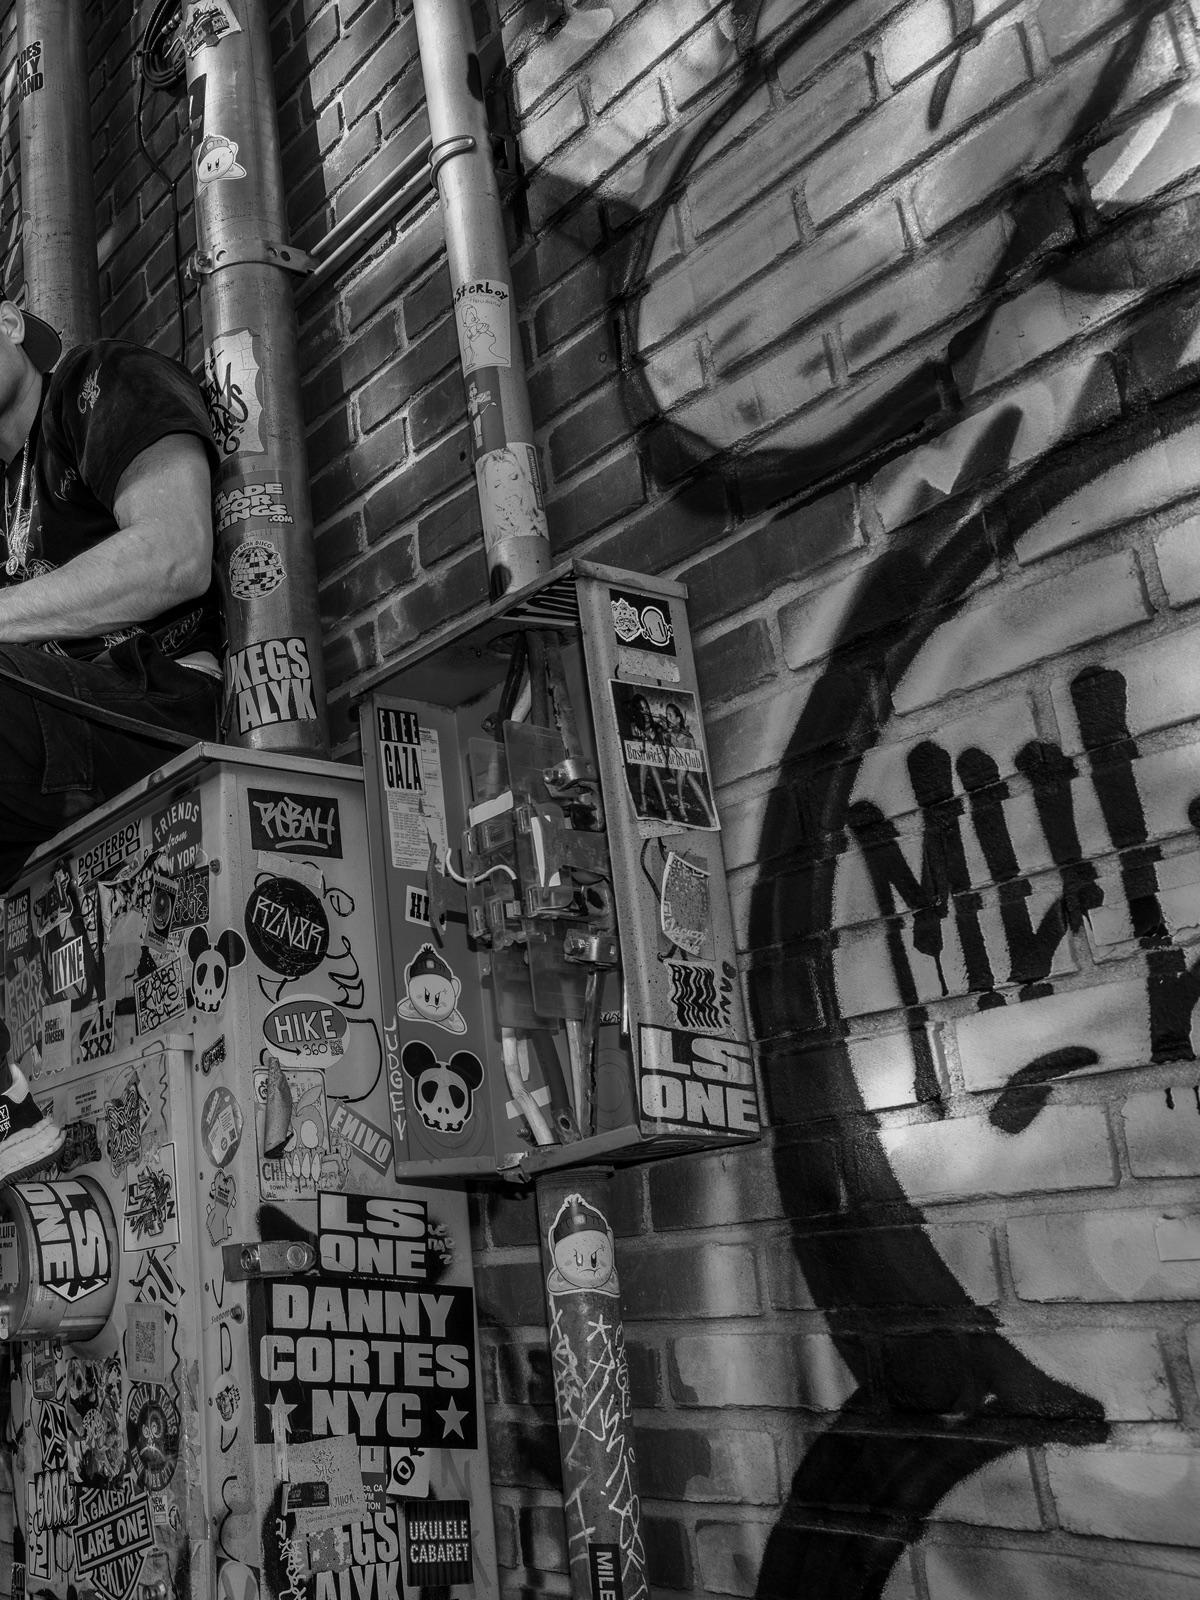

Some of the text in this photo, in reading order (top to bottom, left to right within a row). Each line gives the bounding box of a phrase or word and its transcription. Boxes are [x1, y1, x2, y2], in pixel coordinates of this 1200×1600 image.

[219, 494, 274, 520] FOR
[268, 514, 294, 524] .COM
[230, 639, 310, 694] KEGS
[238, 678, 317, 735] ALYK
[379, 709, 420, 744] FREE
[384, 743, 422, 791] GAZA
[154, 801, 201, 843] FRIENDS
[167, 831, 188, 847] from
[78, 818, 142, 875] POSTERBOY
[45, 1029, 65, 1045] UNSEEN
[274, 1008, 337, 1043] HIKE
[640, 1026, 754, 1085] LS
[641, 1073, 759, 1135] ONE
[17, 1183, 75, 1282] ONE
[47, 1180, 109, 1278] LS
[320, 1196, 427, 1238] LS
[319, 1235, 427, 1278] ONE
[271, 1283, 455, 1338] DANNY
[259, 1334, 470, 1389] CORTES
[310, 1389, 422, 1439] NYC
[90, 1488, 125, 1521] GAKED
[373, 1484, 384, 1492] CA
[79, 1508, 150, 1563] LARE ONE
[409, 1520, 469, 1542] UKULELE
[409, 1544, 470, 1564] CABARET
[99, 1554, 137, 1598] BKLYN
